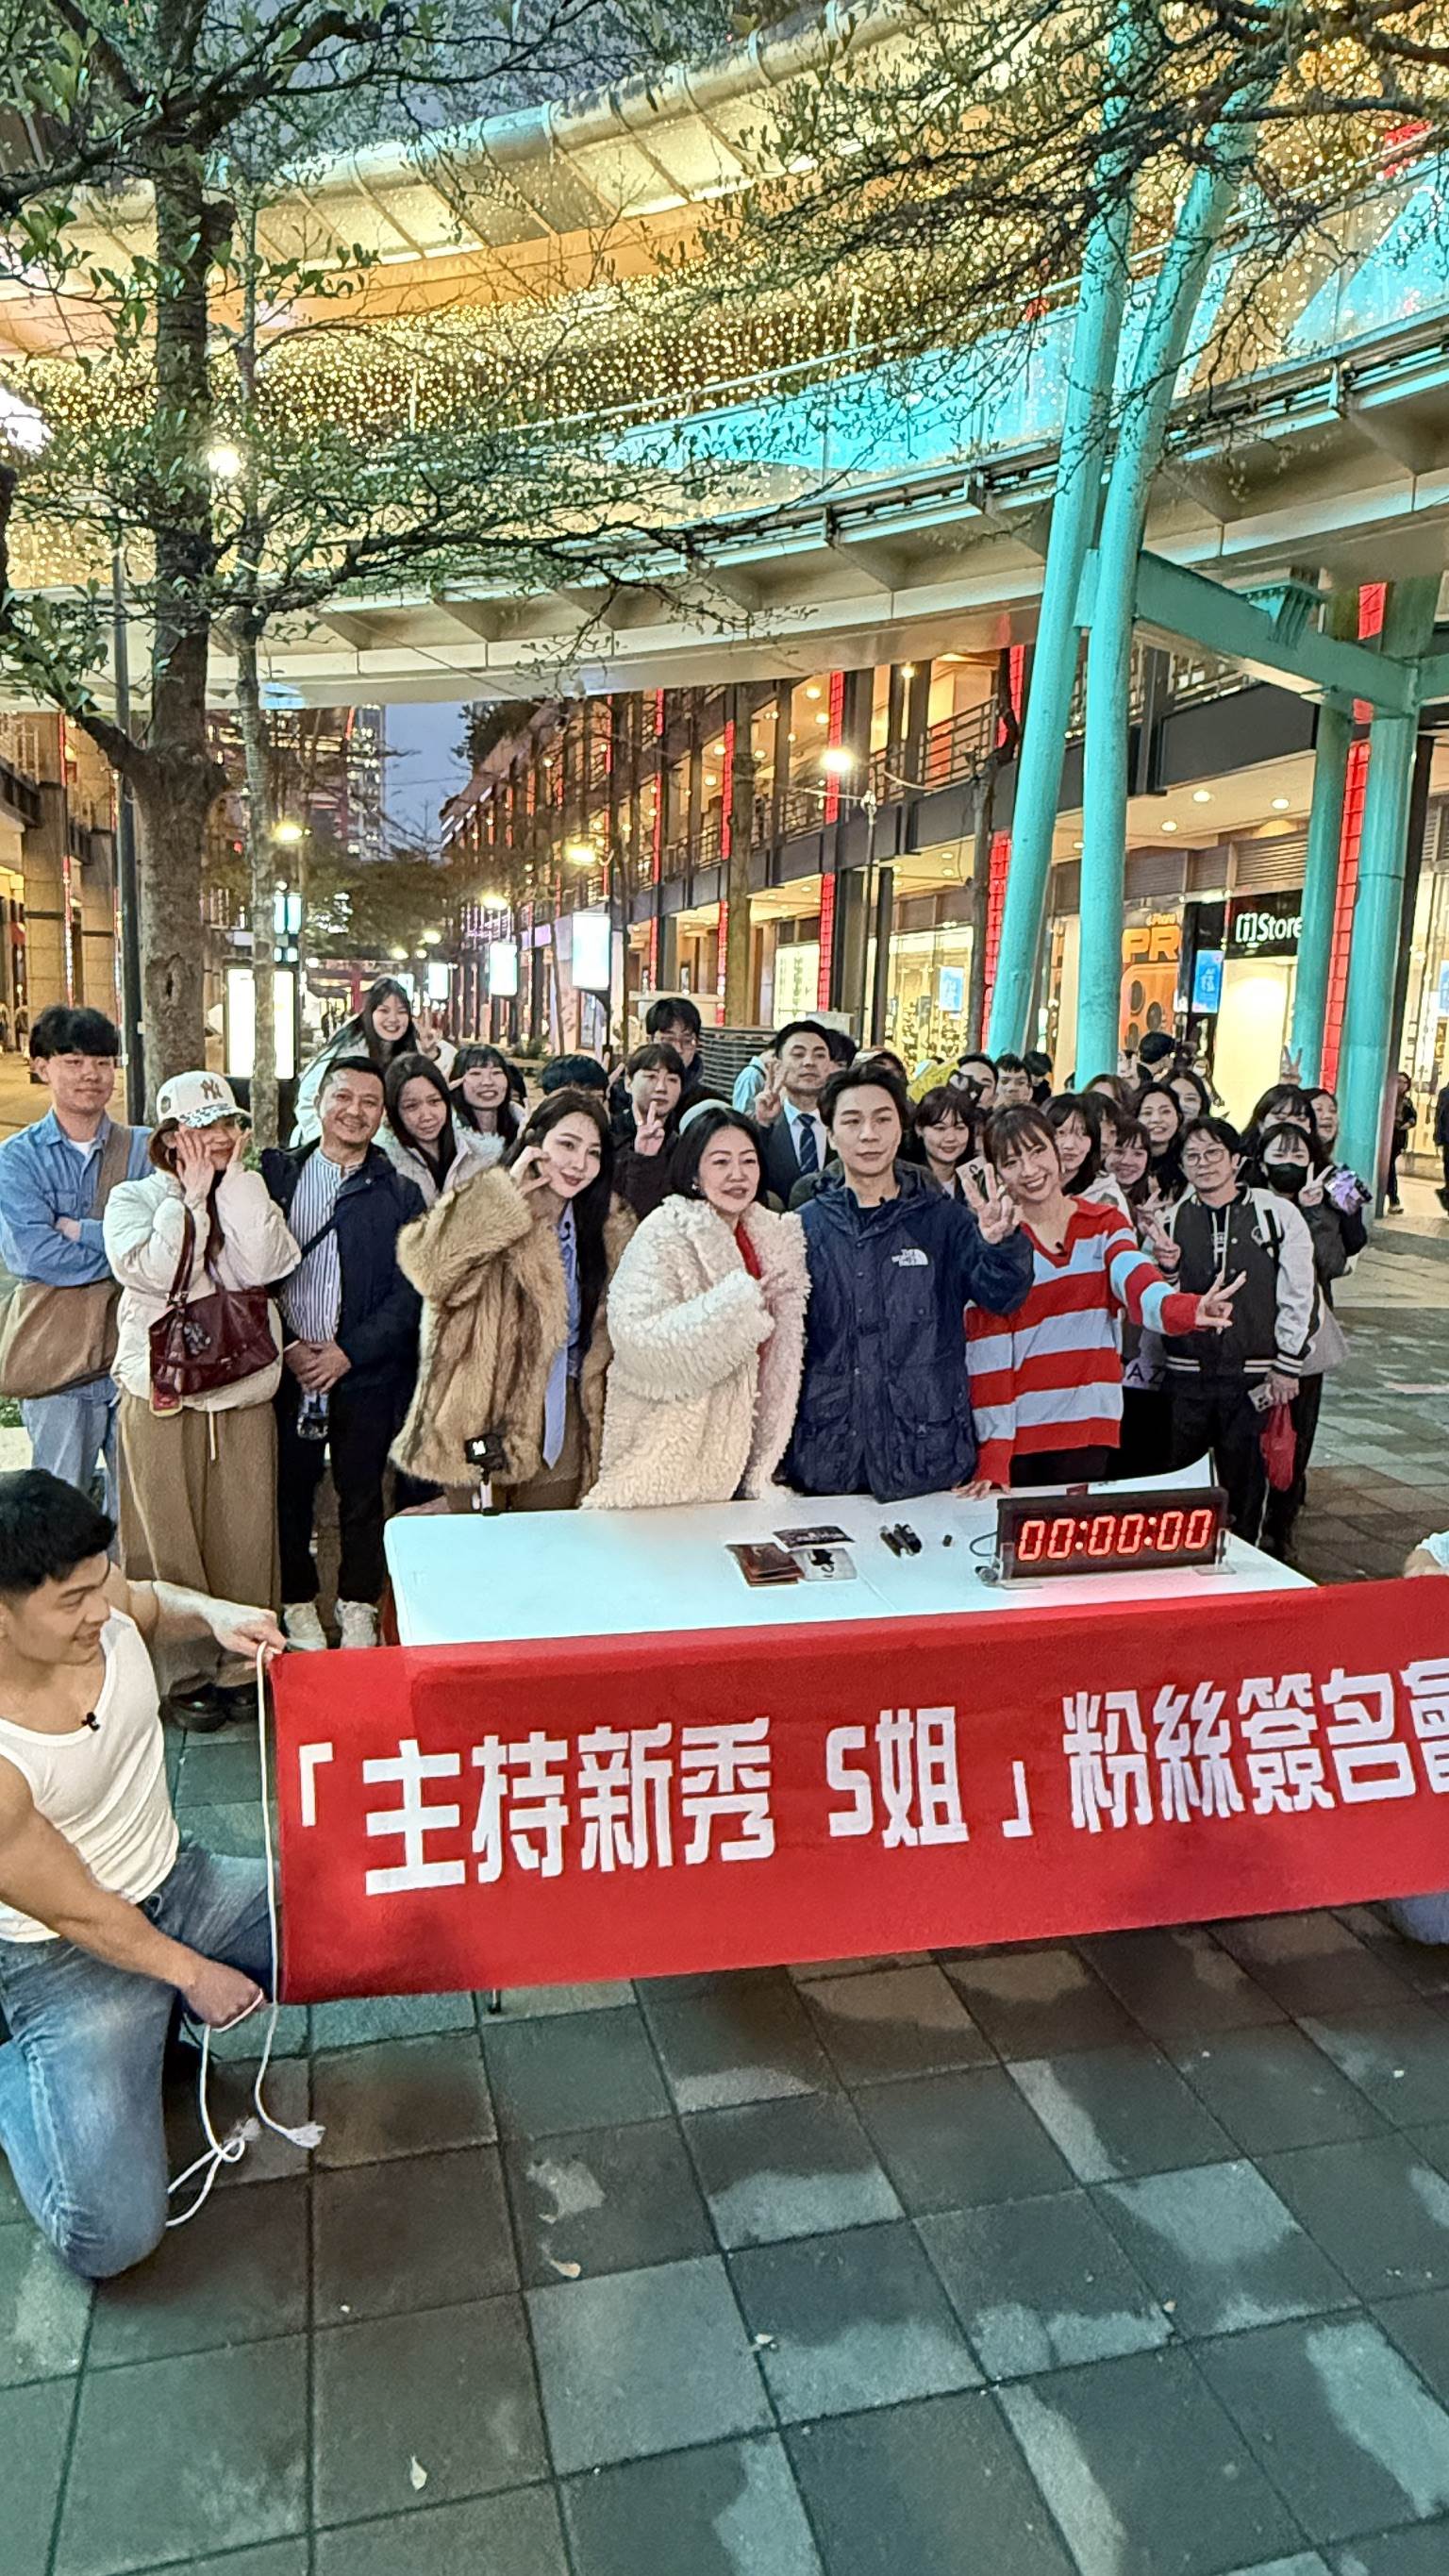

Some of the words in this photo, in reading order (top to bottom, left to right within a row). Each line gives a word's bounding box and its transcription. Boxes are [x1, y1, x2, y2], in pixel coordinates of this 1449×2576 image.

[200, 1079, 224, 1100] NY
[1018, 1509, 1213, 1562] 00:00:00
[298, 1716, 775, 1897] 「主持新秀
